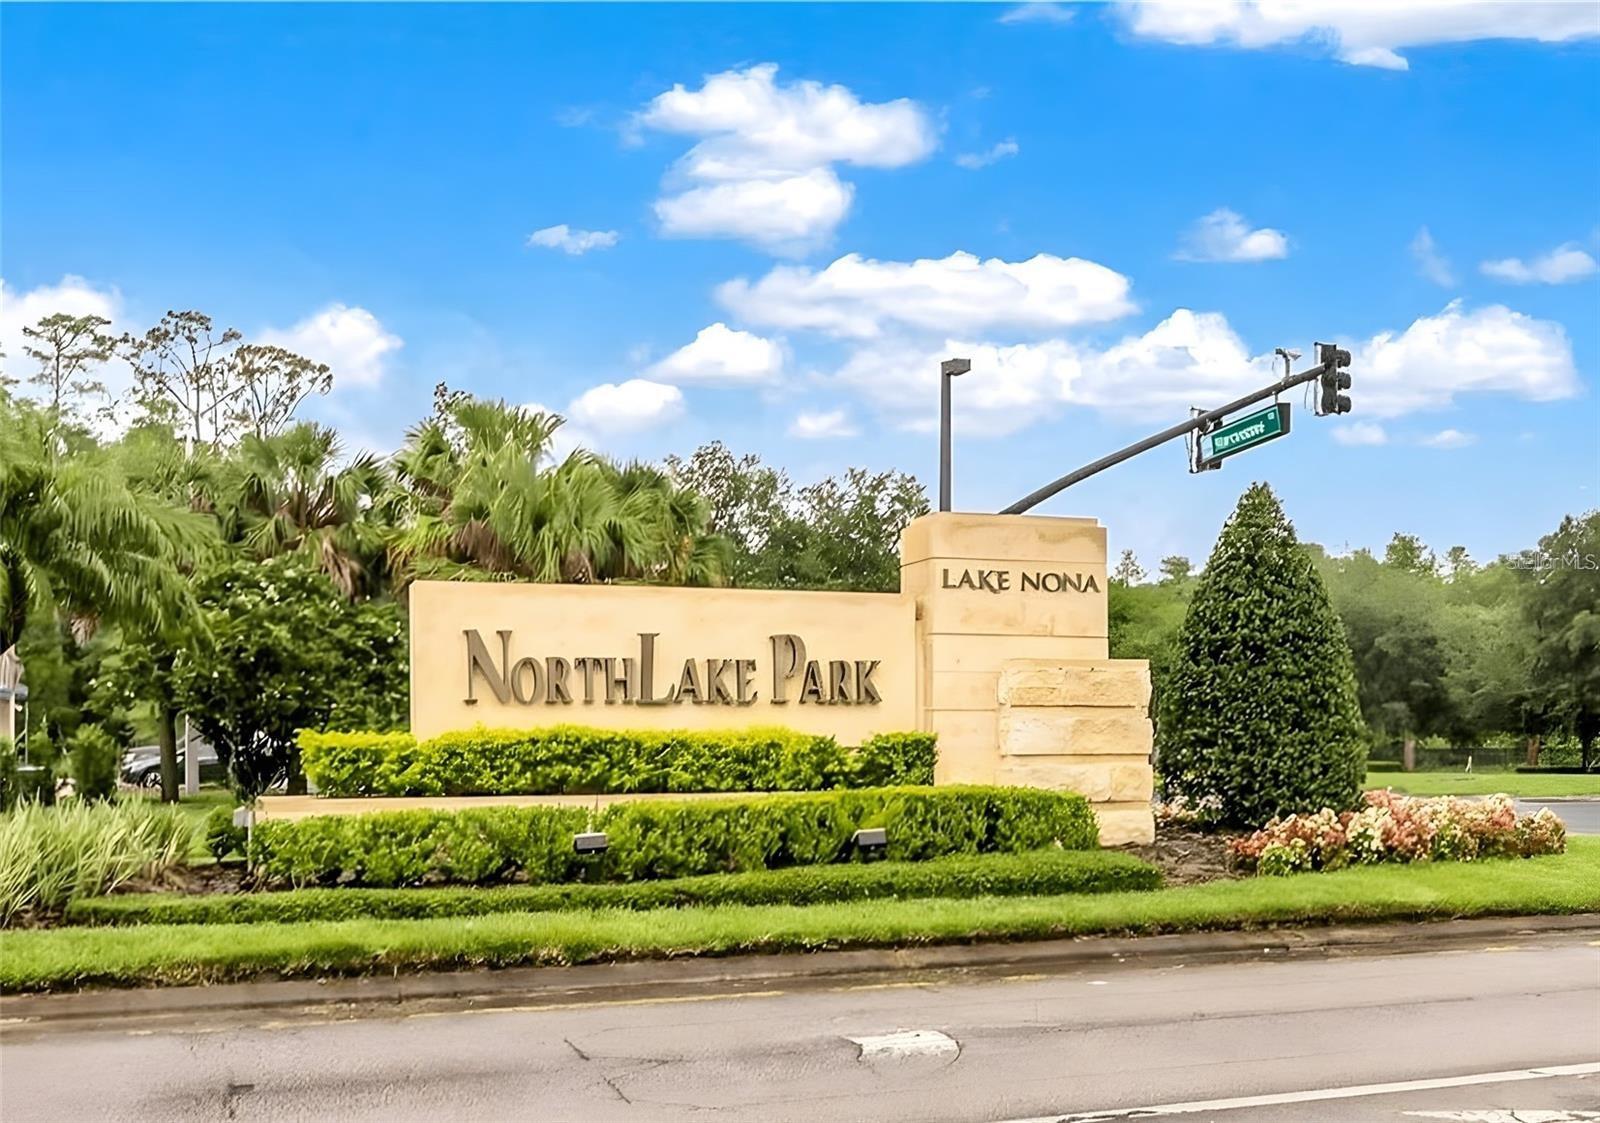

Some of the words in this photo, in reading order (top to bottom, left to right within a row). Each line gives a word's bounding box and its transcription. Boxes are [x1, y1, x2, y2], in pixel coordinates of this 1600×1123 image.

[942, 568, 1010, 594] LAKE
[1020, 572, 1101, 593] NONA
[769, 634, 882, 705] PARK
